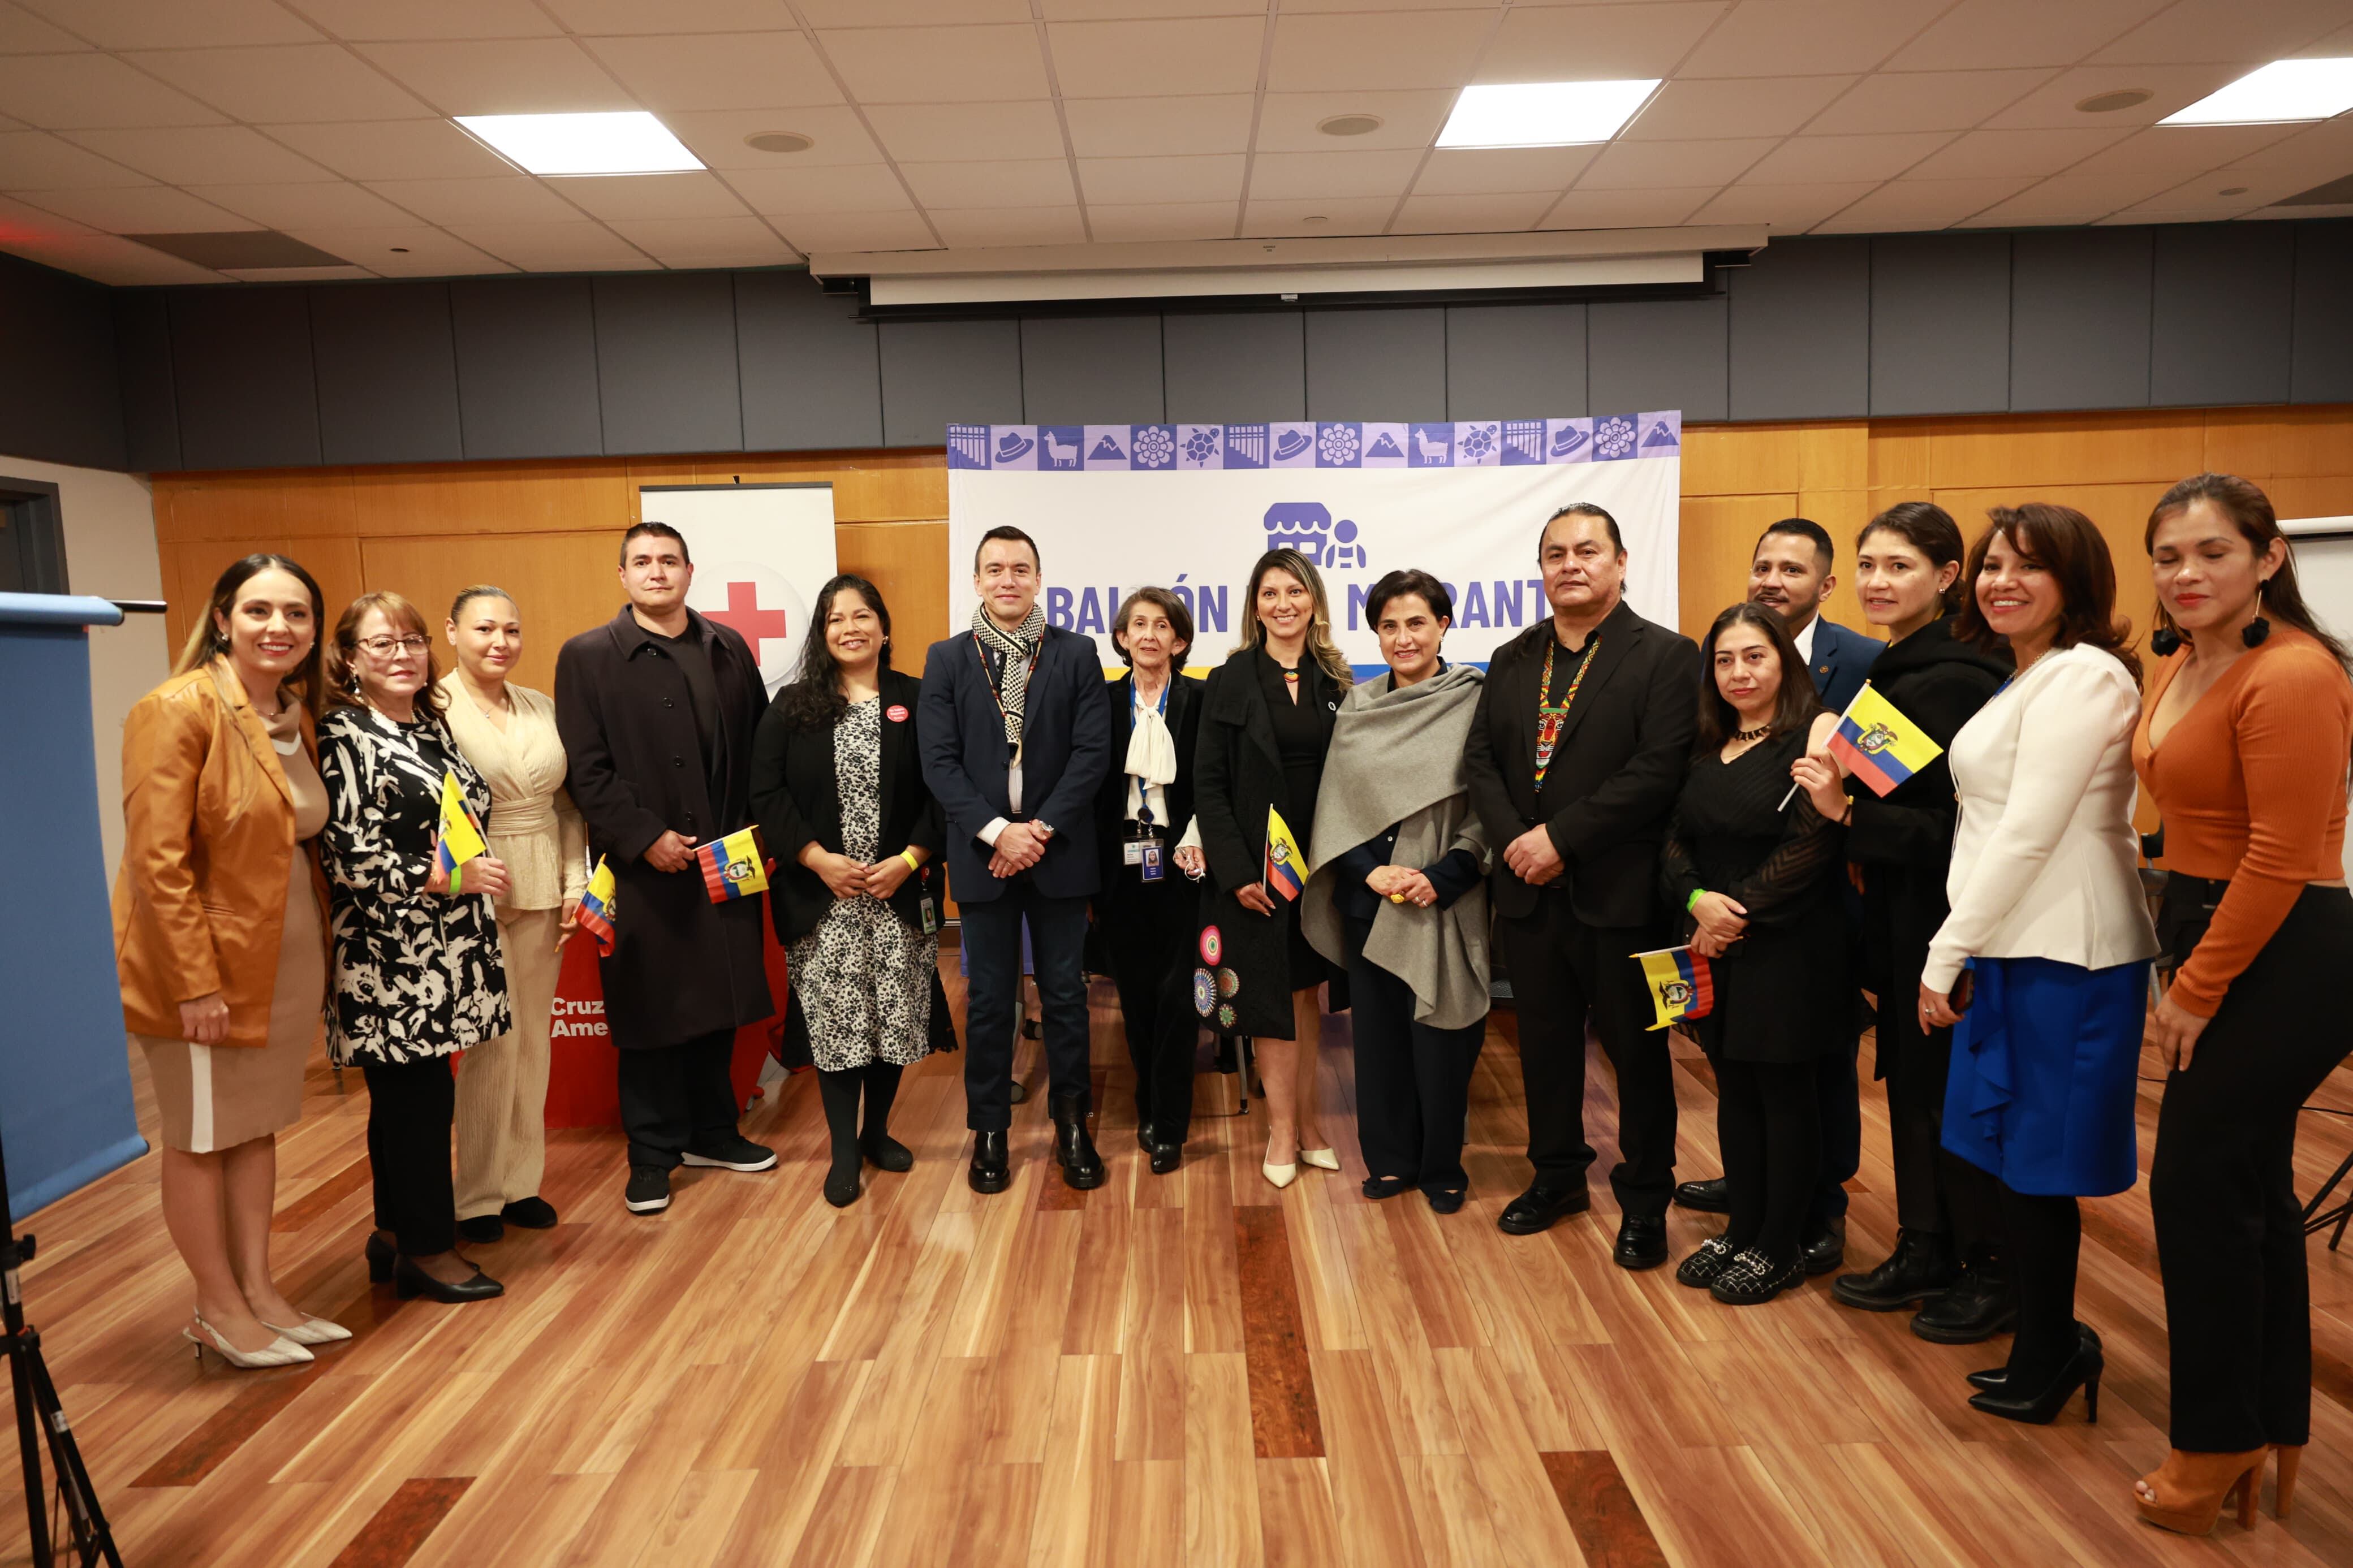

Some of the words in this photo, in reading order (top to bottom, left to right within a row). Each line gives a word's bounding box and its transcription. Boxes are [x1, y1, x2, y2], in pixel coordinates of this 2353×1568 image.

[1047, 574, 1227, 634] BALÓN
[1348, 580, 1545, 631] MRANT
[551, 997, 605, 1016] Cruz
[551, 1020, 608, 1038] Ame
